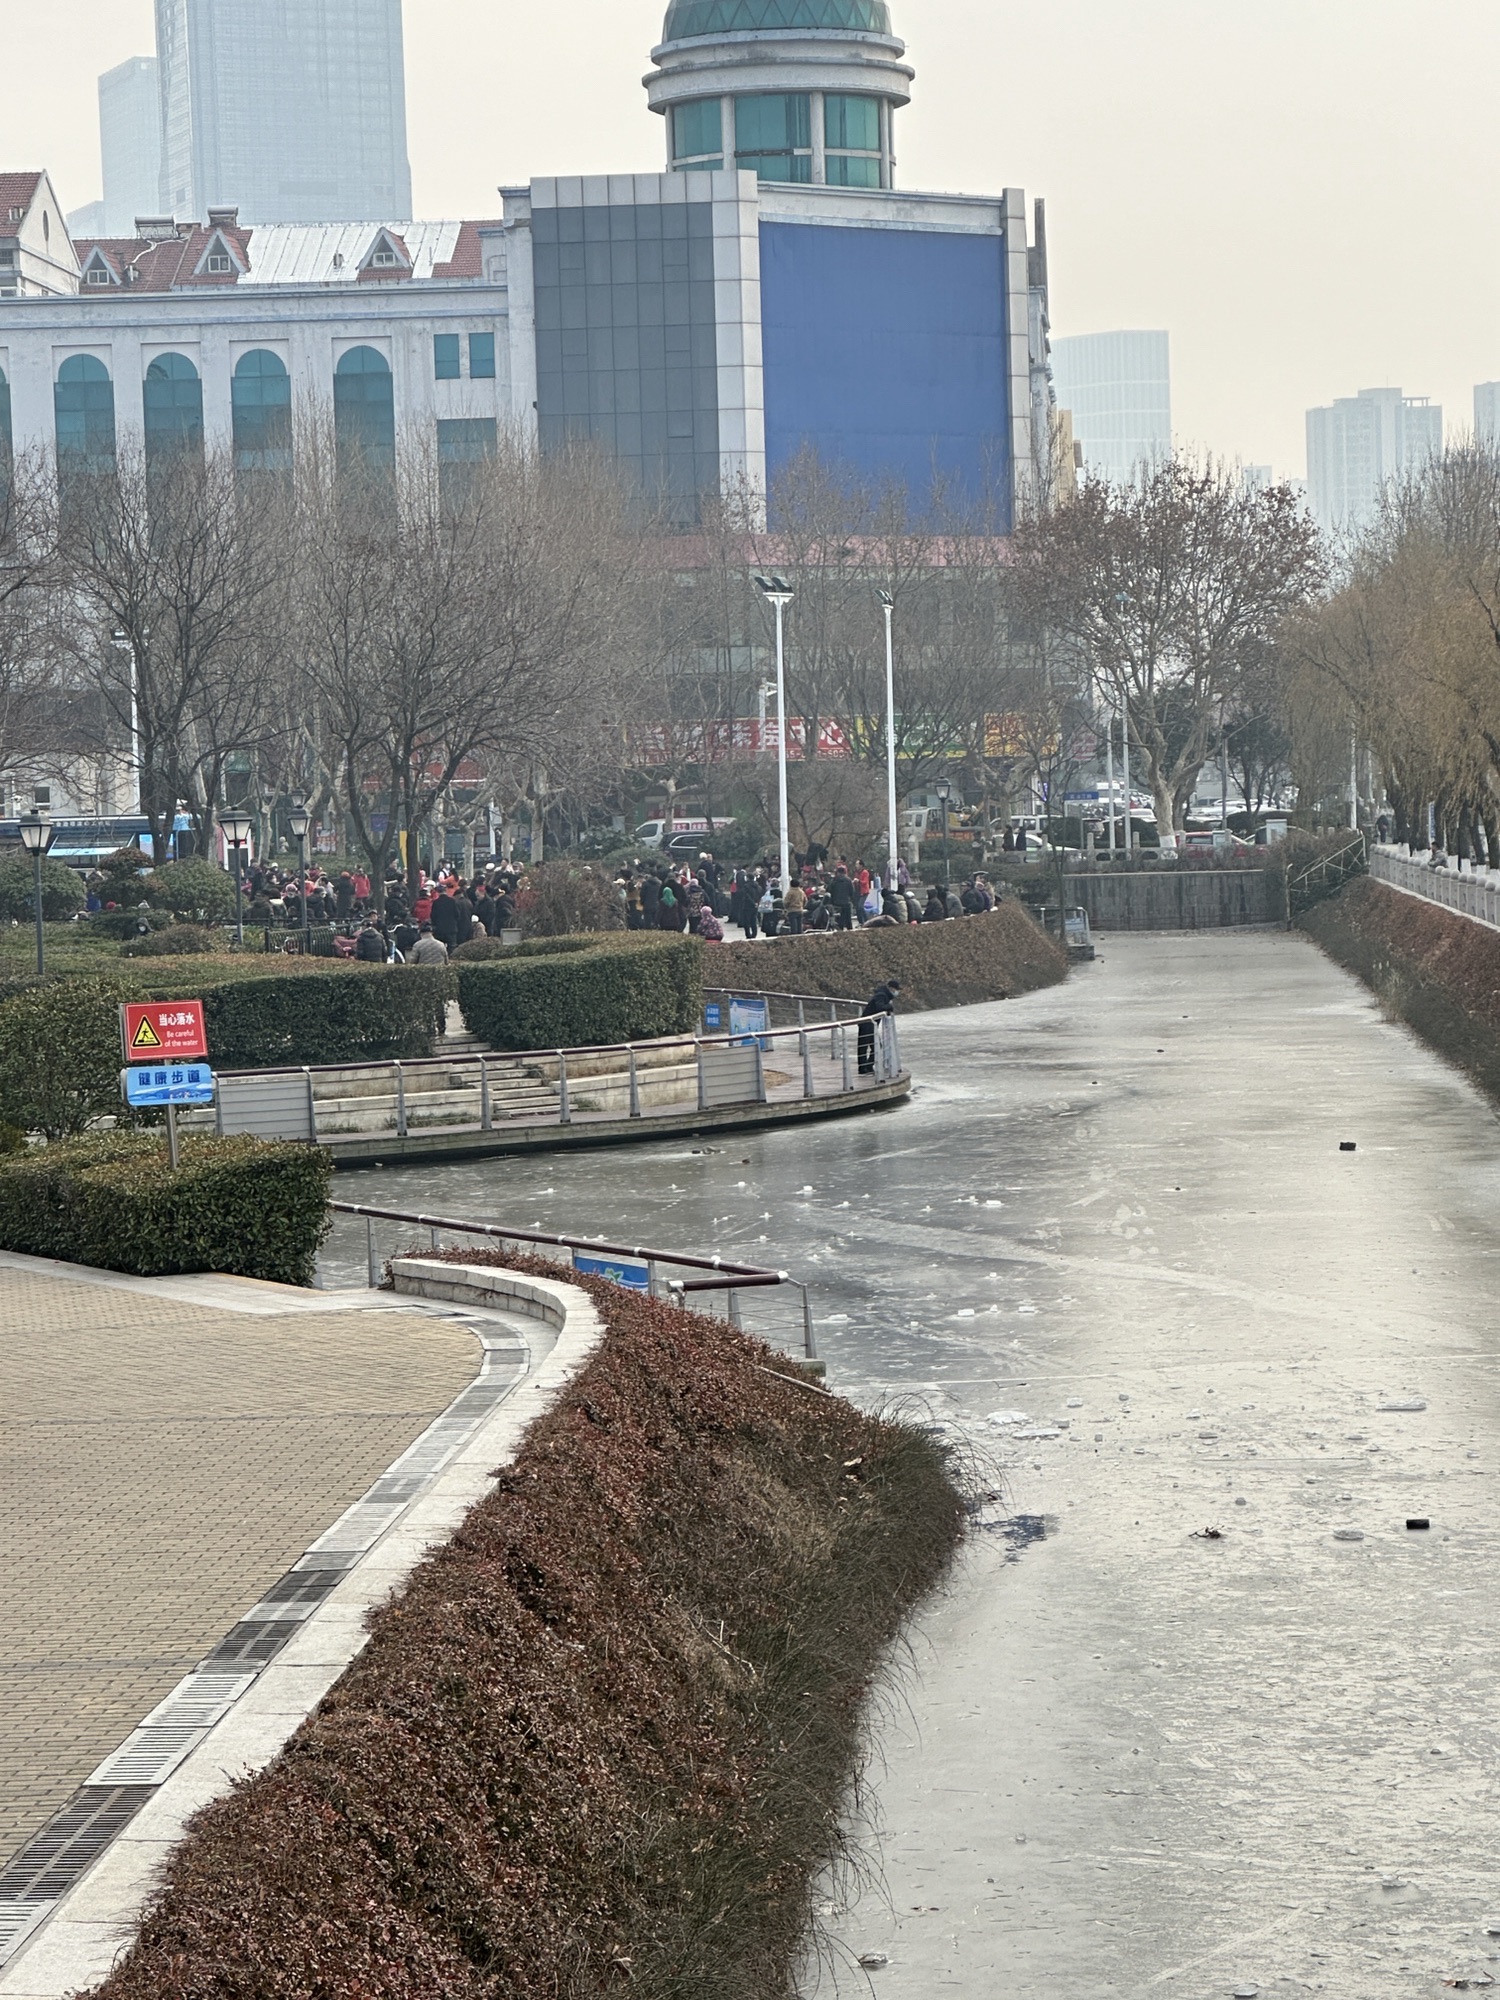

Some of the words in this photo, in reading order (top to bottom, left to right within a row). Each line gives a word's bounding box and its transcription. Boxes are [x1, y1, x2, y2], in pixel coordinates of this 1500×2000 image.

[159, 1012, 195, 1026] 当心落水
[175, 1029, 194, 1037] careful
[171, 1039, 181, 1047] the
[139, 1069, 200, 1085] 健康步道
